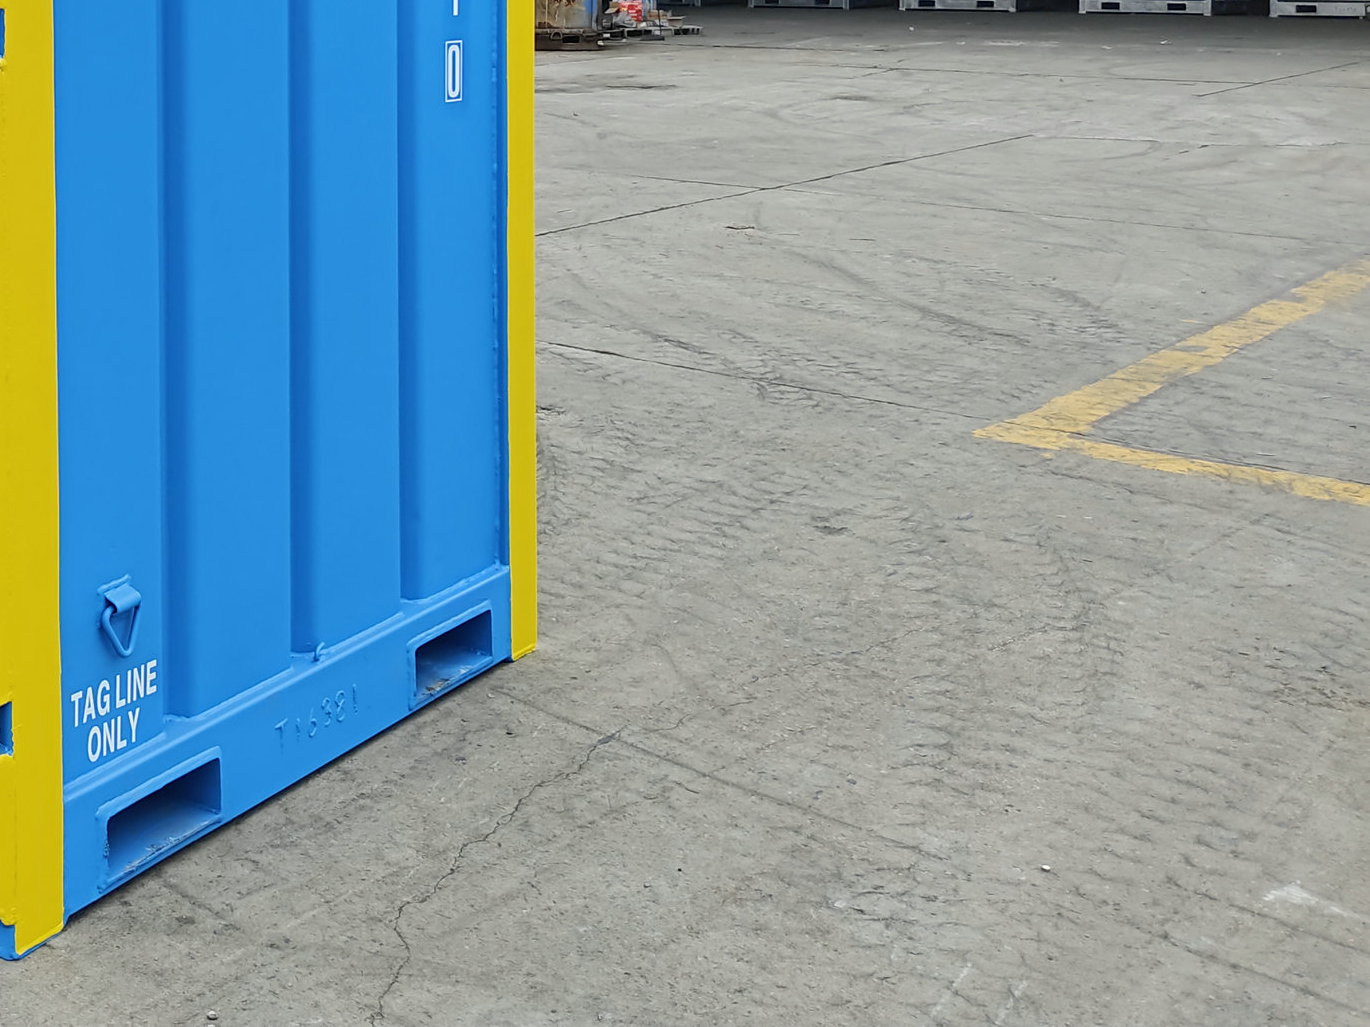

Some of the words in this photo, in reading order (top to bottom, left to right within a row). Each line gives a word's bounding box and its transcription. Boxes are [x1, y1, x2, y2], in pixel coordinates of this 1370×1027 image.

[71, 680, 111, 727] TAG
[116, 659, 157, 708] LINE
[87, 707, 140, 763] ONLY
